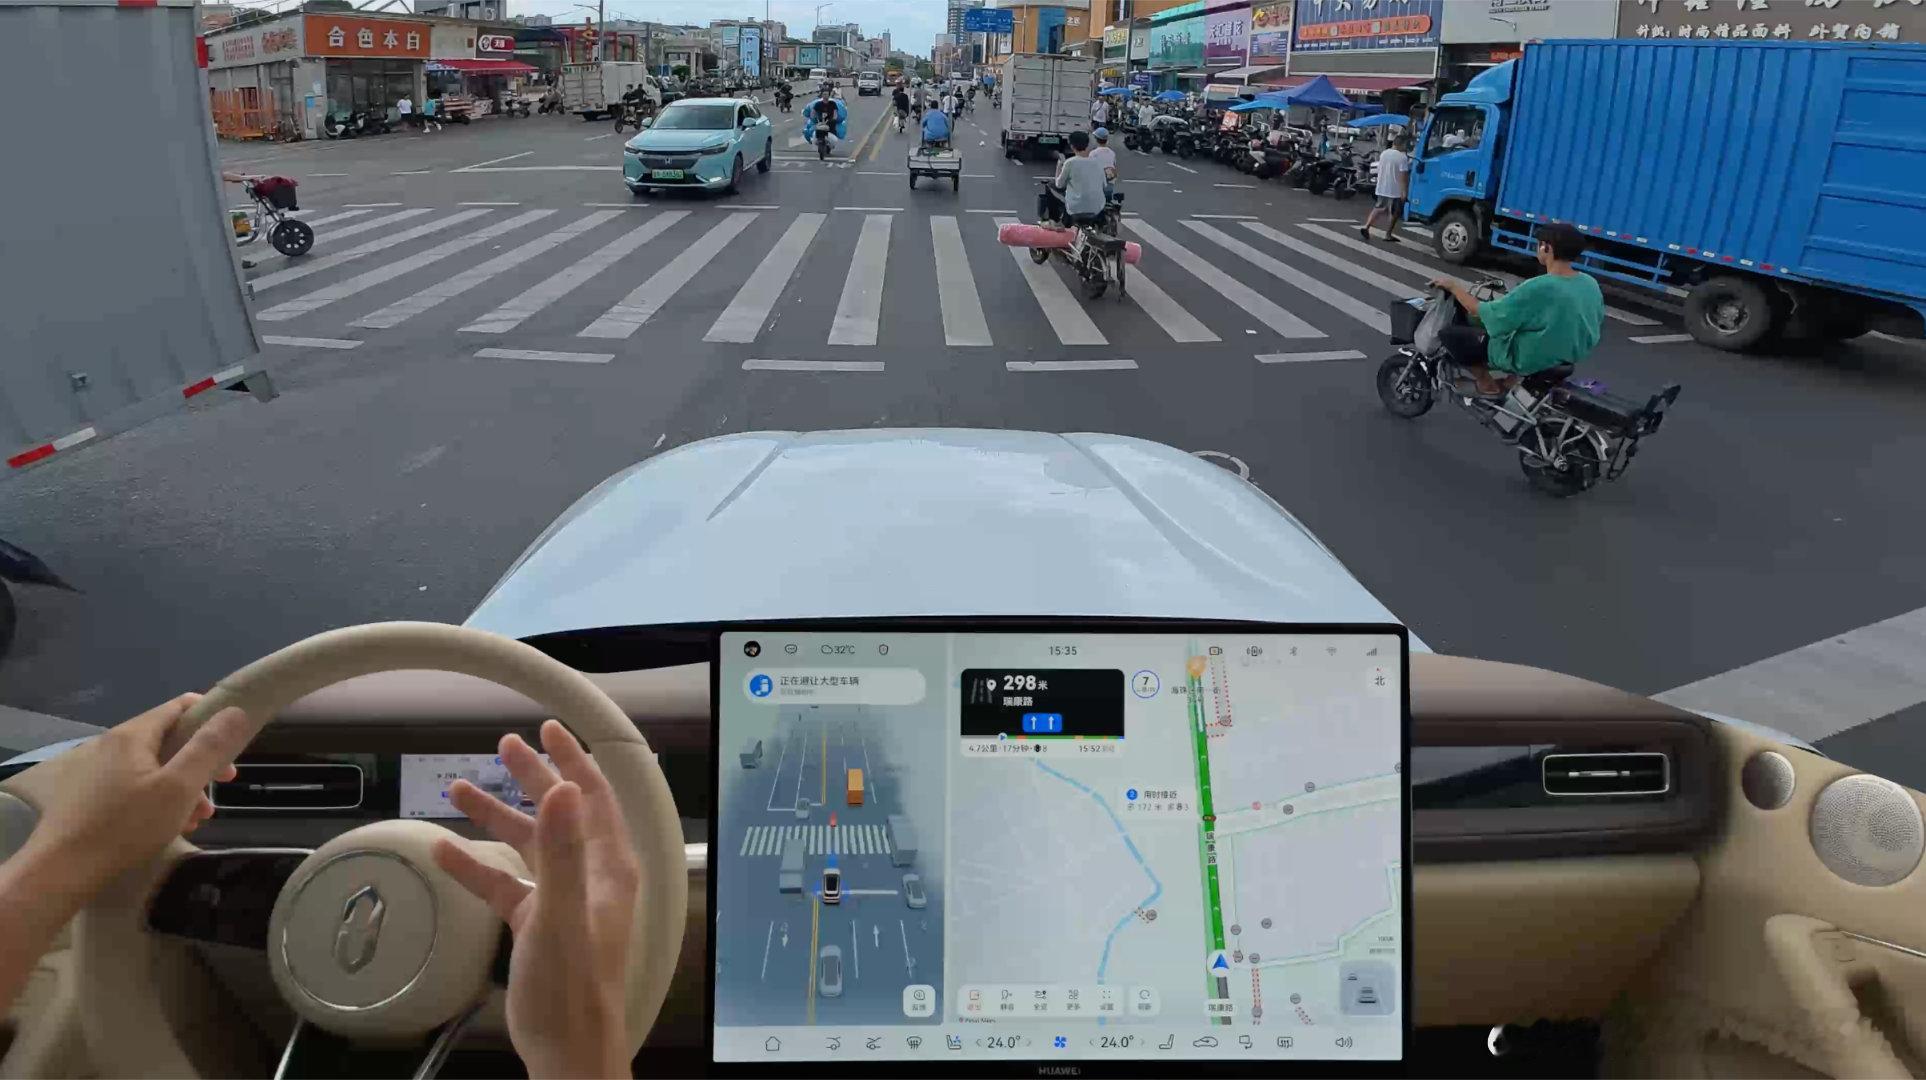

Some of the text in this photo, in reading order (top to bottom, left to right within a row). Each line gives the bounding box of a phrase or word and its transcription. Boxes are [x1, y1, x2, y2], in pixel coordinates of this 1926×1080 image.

[328, 25, 420, 50] 合色本白
[1048, 646, 1078, 656] 15:35
[1142, 676, 1149, 685] 7
[1375, 676, 1386, 686] 北
[987, 1035, 1021, 1049] 24.0°
[1101, 1035, 1134, 1049] 24.0°
[1038, 1066, 1081, 1075] HUAWEI
